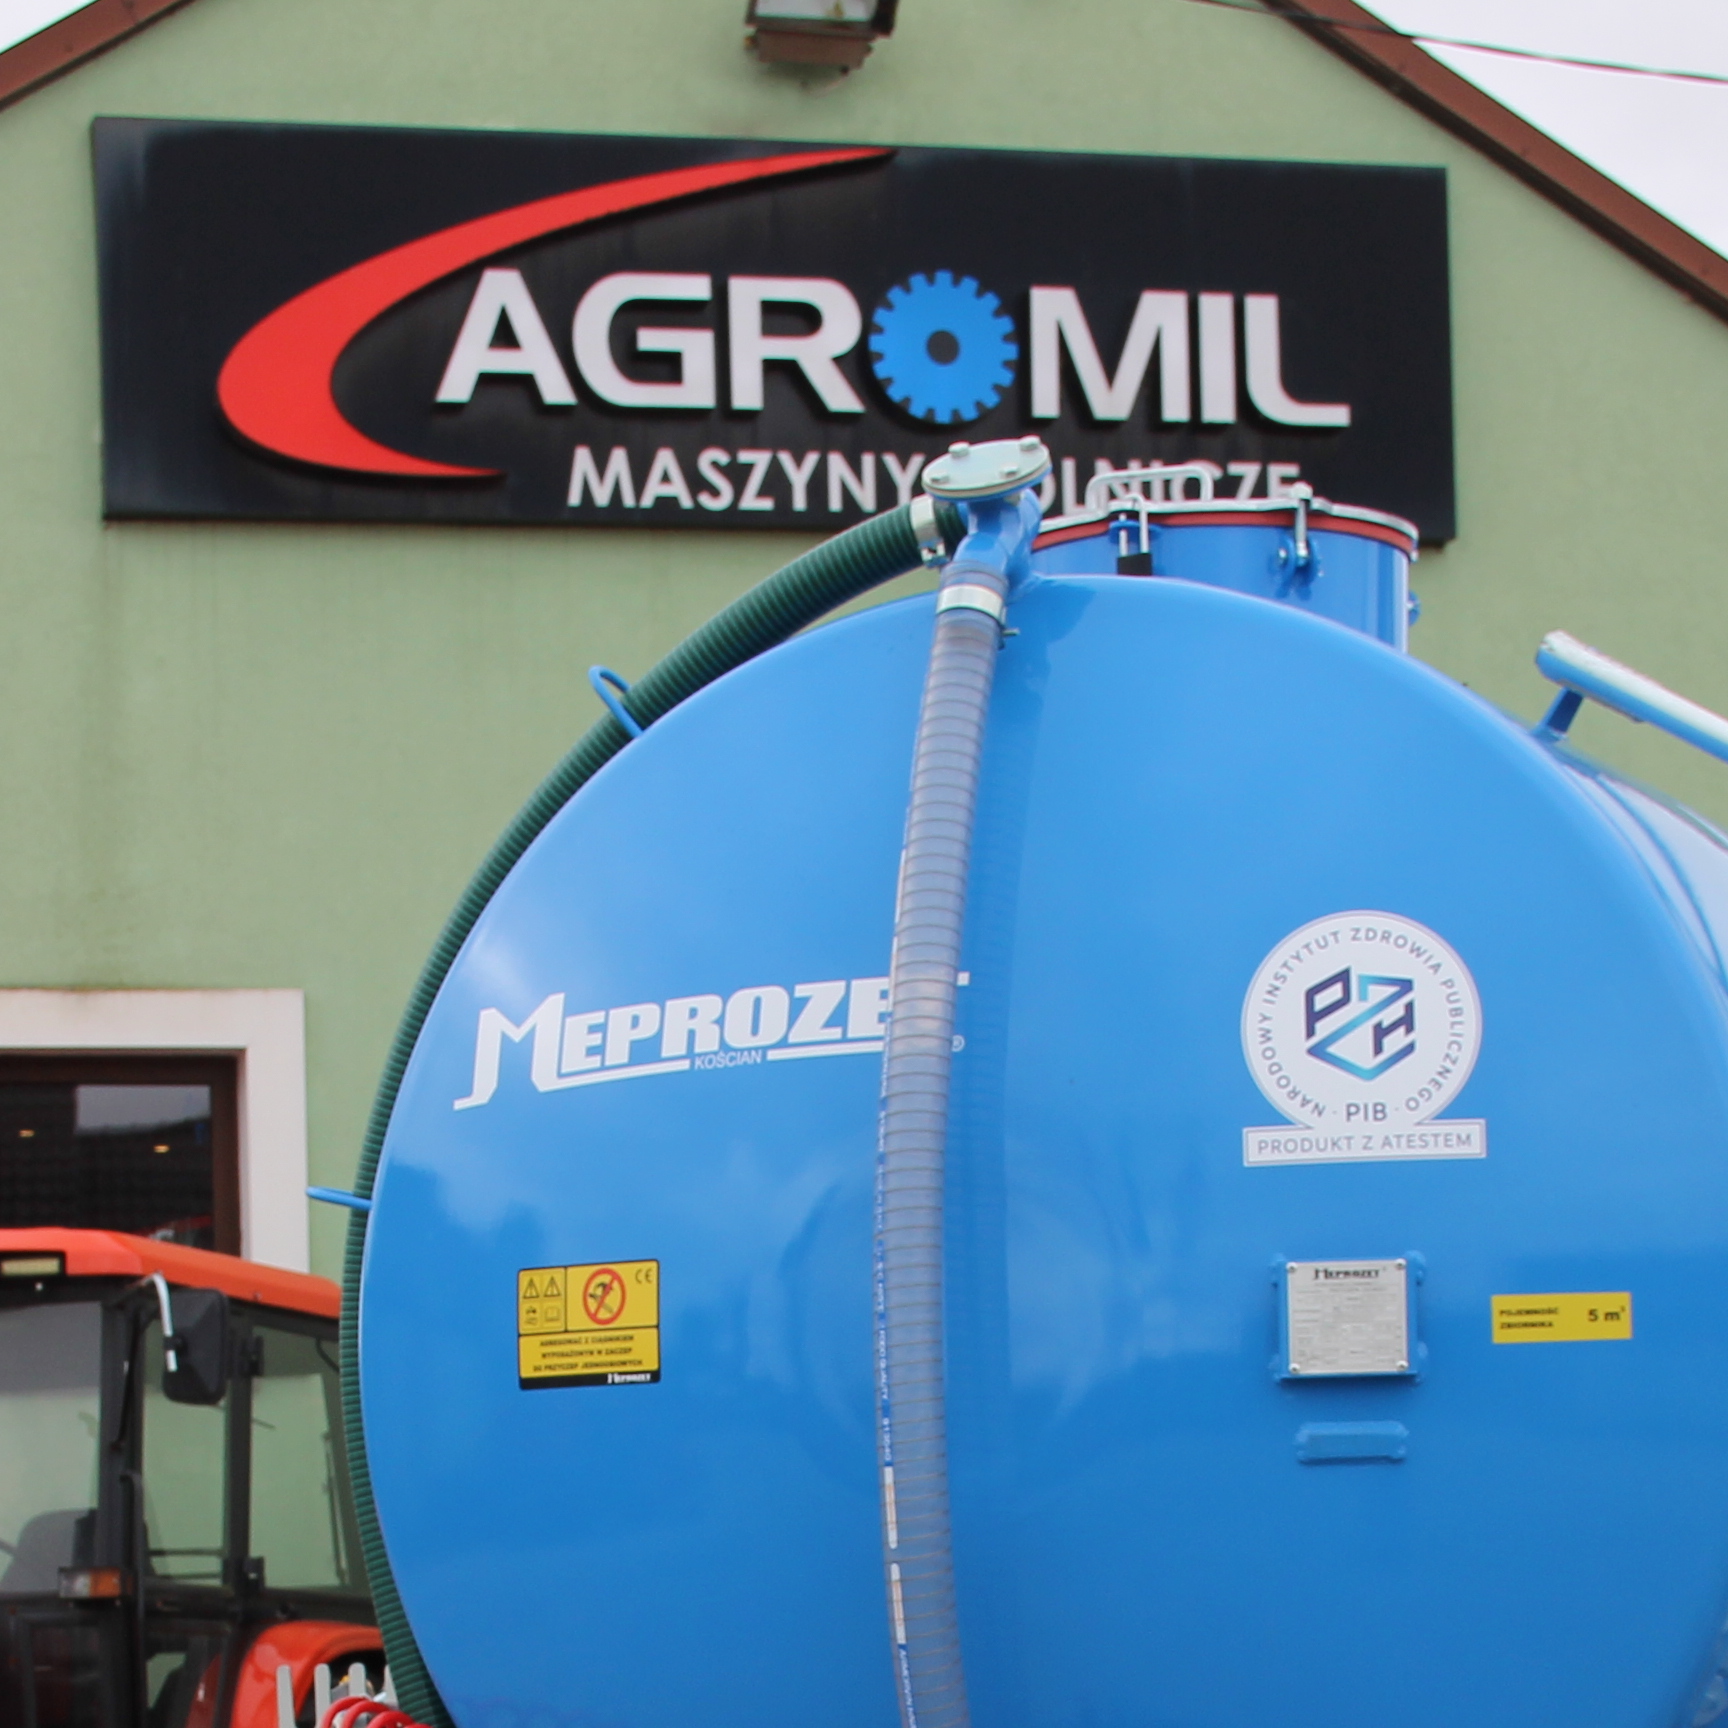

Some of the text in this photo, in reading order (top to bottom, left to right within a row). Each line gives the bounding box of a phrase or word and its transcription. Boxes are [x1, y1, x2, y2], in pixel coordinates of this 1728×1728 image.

[565, 445, 1301, 516] MASZYNY LNICZE
[1257, 927, 1465, 1118] NARODOWY INSTYTUT ZDROWIA PUBLICZNEGO
[453, 971, 970, 1110] MEPROZE
[694, 1050, 762, 1071] KOŚCIAN
[1345, 1102, 1388, 1122] PIB
[1257, 1132, 1473, 1155] PRODUKT Z ATESTEM
[1588, 1308, 1599, 1322] 5
